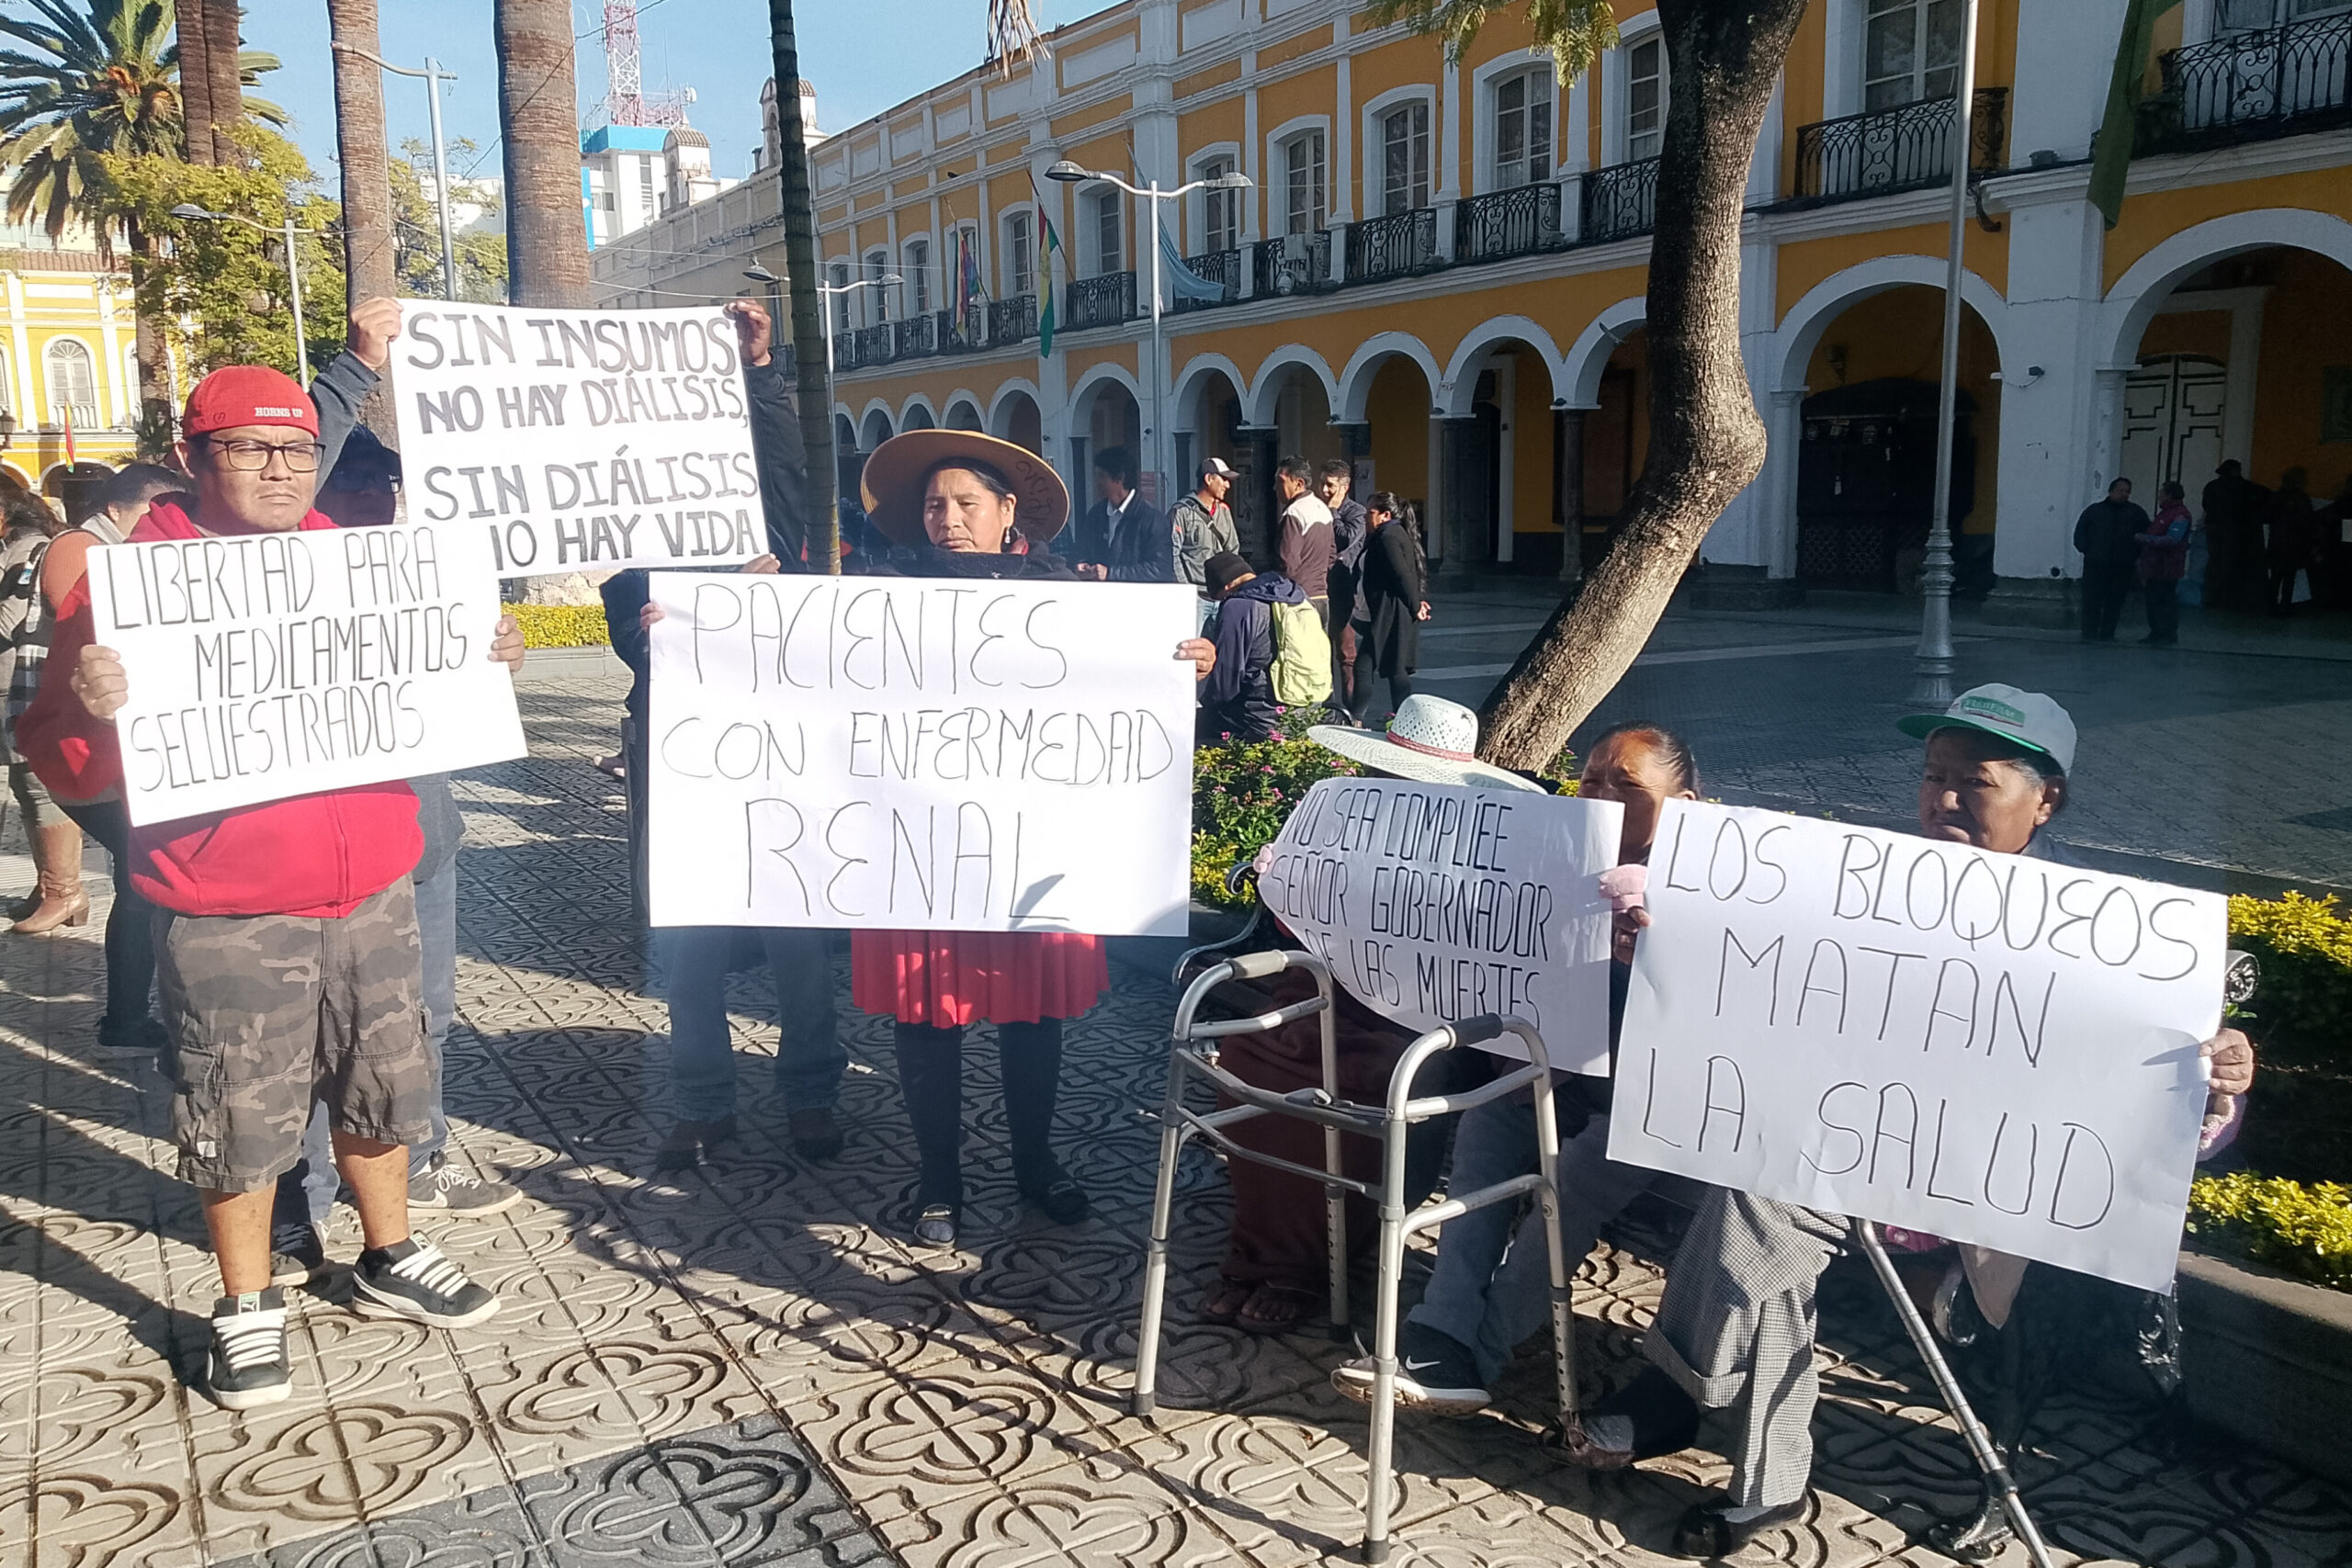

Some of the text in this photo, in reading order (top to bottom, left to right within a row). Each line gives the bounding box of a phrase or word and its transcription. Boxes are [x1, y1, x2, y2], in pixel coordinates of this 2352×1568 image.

[407, 311, 736, 376] SIN INSUMOS
[254, 406, 291, 418] HORNS
[416, 369, 750, 434] NO HAY DIÁLISIS,
[424, 444, 758, 521] SIN DIÁLISIS
[107, 526, 441, 629] LIBERTAD PARA
[555, 513, 641, 565] HAY
[655, 509, 761, 558] VIDA
[195, 603, 468, 701] MEDICAMENTOS
[691, 579, 1068, 694] PACIENTES
[130, 681, 424, 792] SECUESTRADOS
[662, 707, 1173, 786] CON ENFERMEDAD
[745, 798, 1069, 921] RENAL
[1283, 787, 1329, 846] NO
[1323, 788, 1382, 852] SEA
[1270, 851, 1553, 962] SEÑOR GOBERNADOR
[1666, 812, 2198, 980] LOS BLOQUEOS
[1305, 929, 1540, 1031] DE LAS MUERTES
[1715, 927, 2056, 1068] MATAN
[1643, 1047, 2115, 1229] LA SALUD
